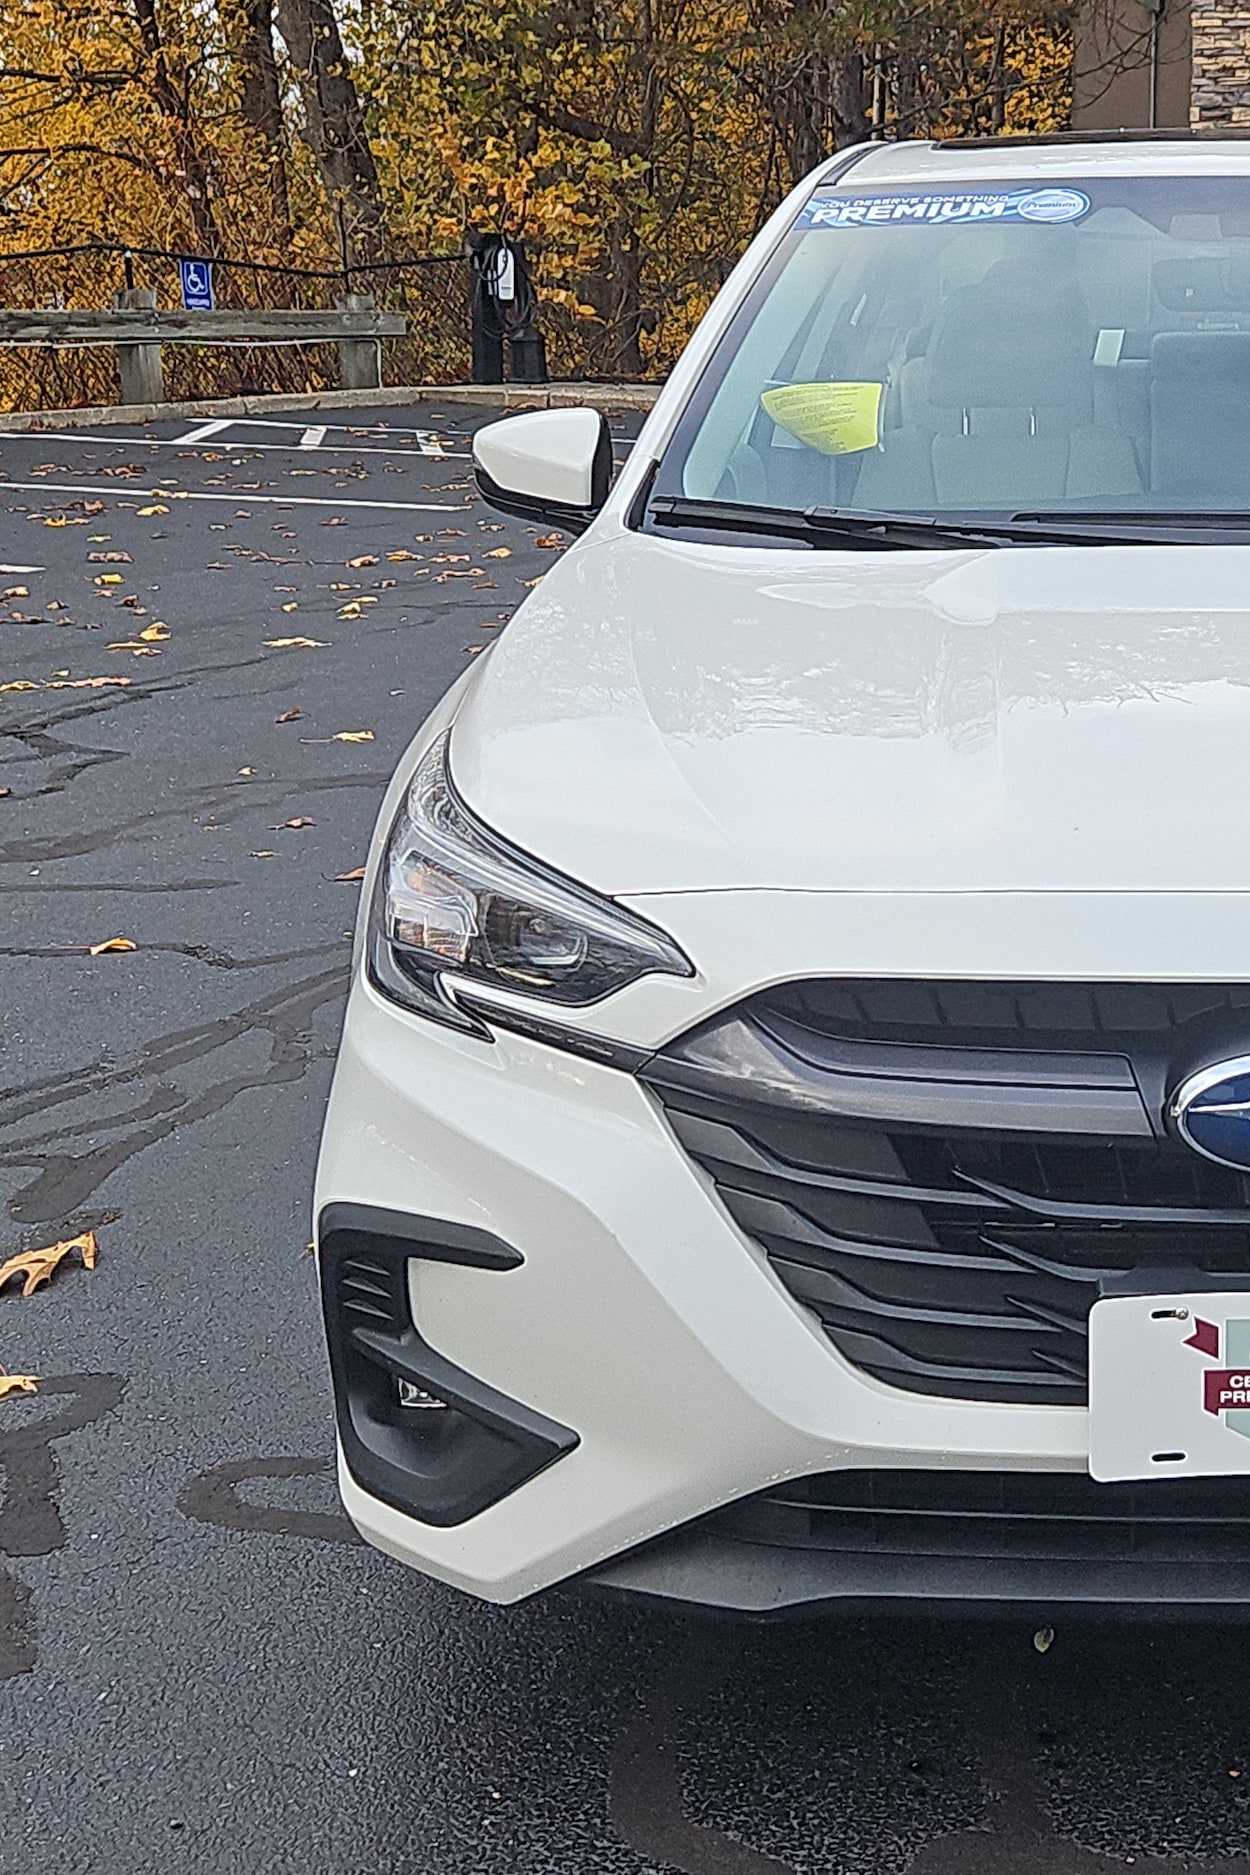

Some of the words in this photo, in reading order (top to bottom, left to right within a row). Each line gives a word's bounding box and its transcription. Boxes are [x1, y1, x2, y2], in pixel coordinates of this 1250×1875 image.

[820, 200, 850, 208] YOU
[853, 197, 920, 207] DESERVE
[923, 195, 1009, 203] SOMETHING
[810, 202, 1006, 224] PREMIUM
